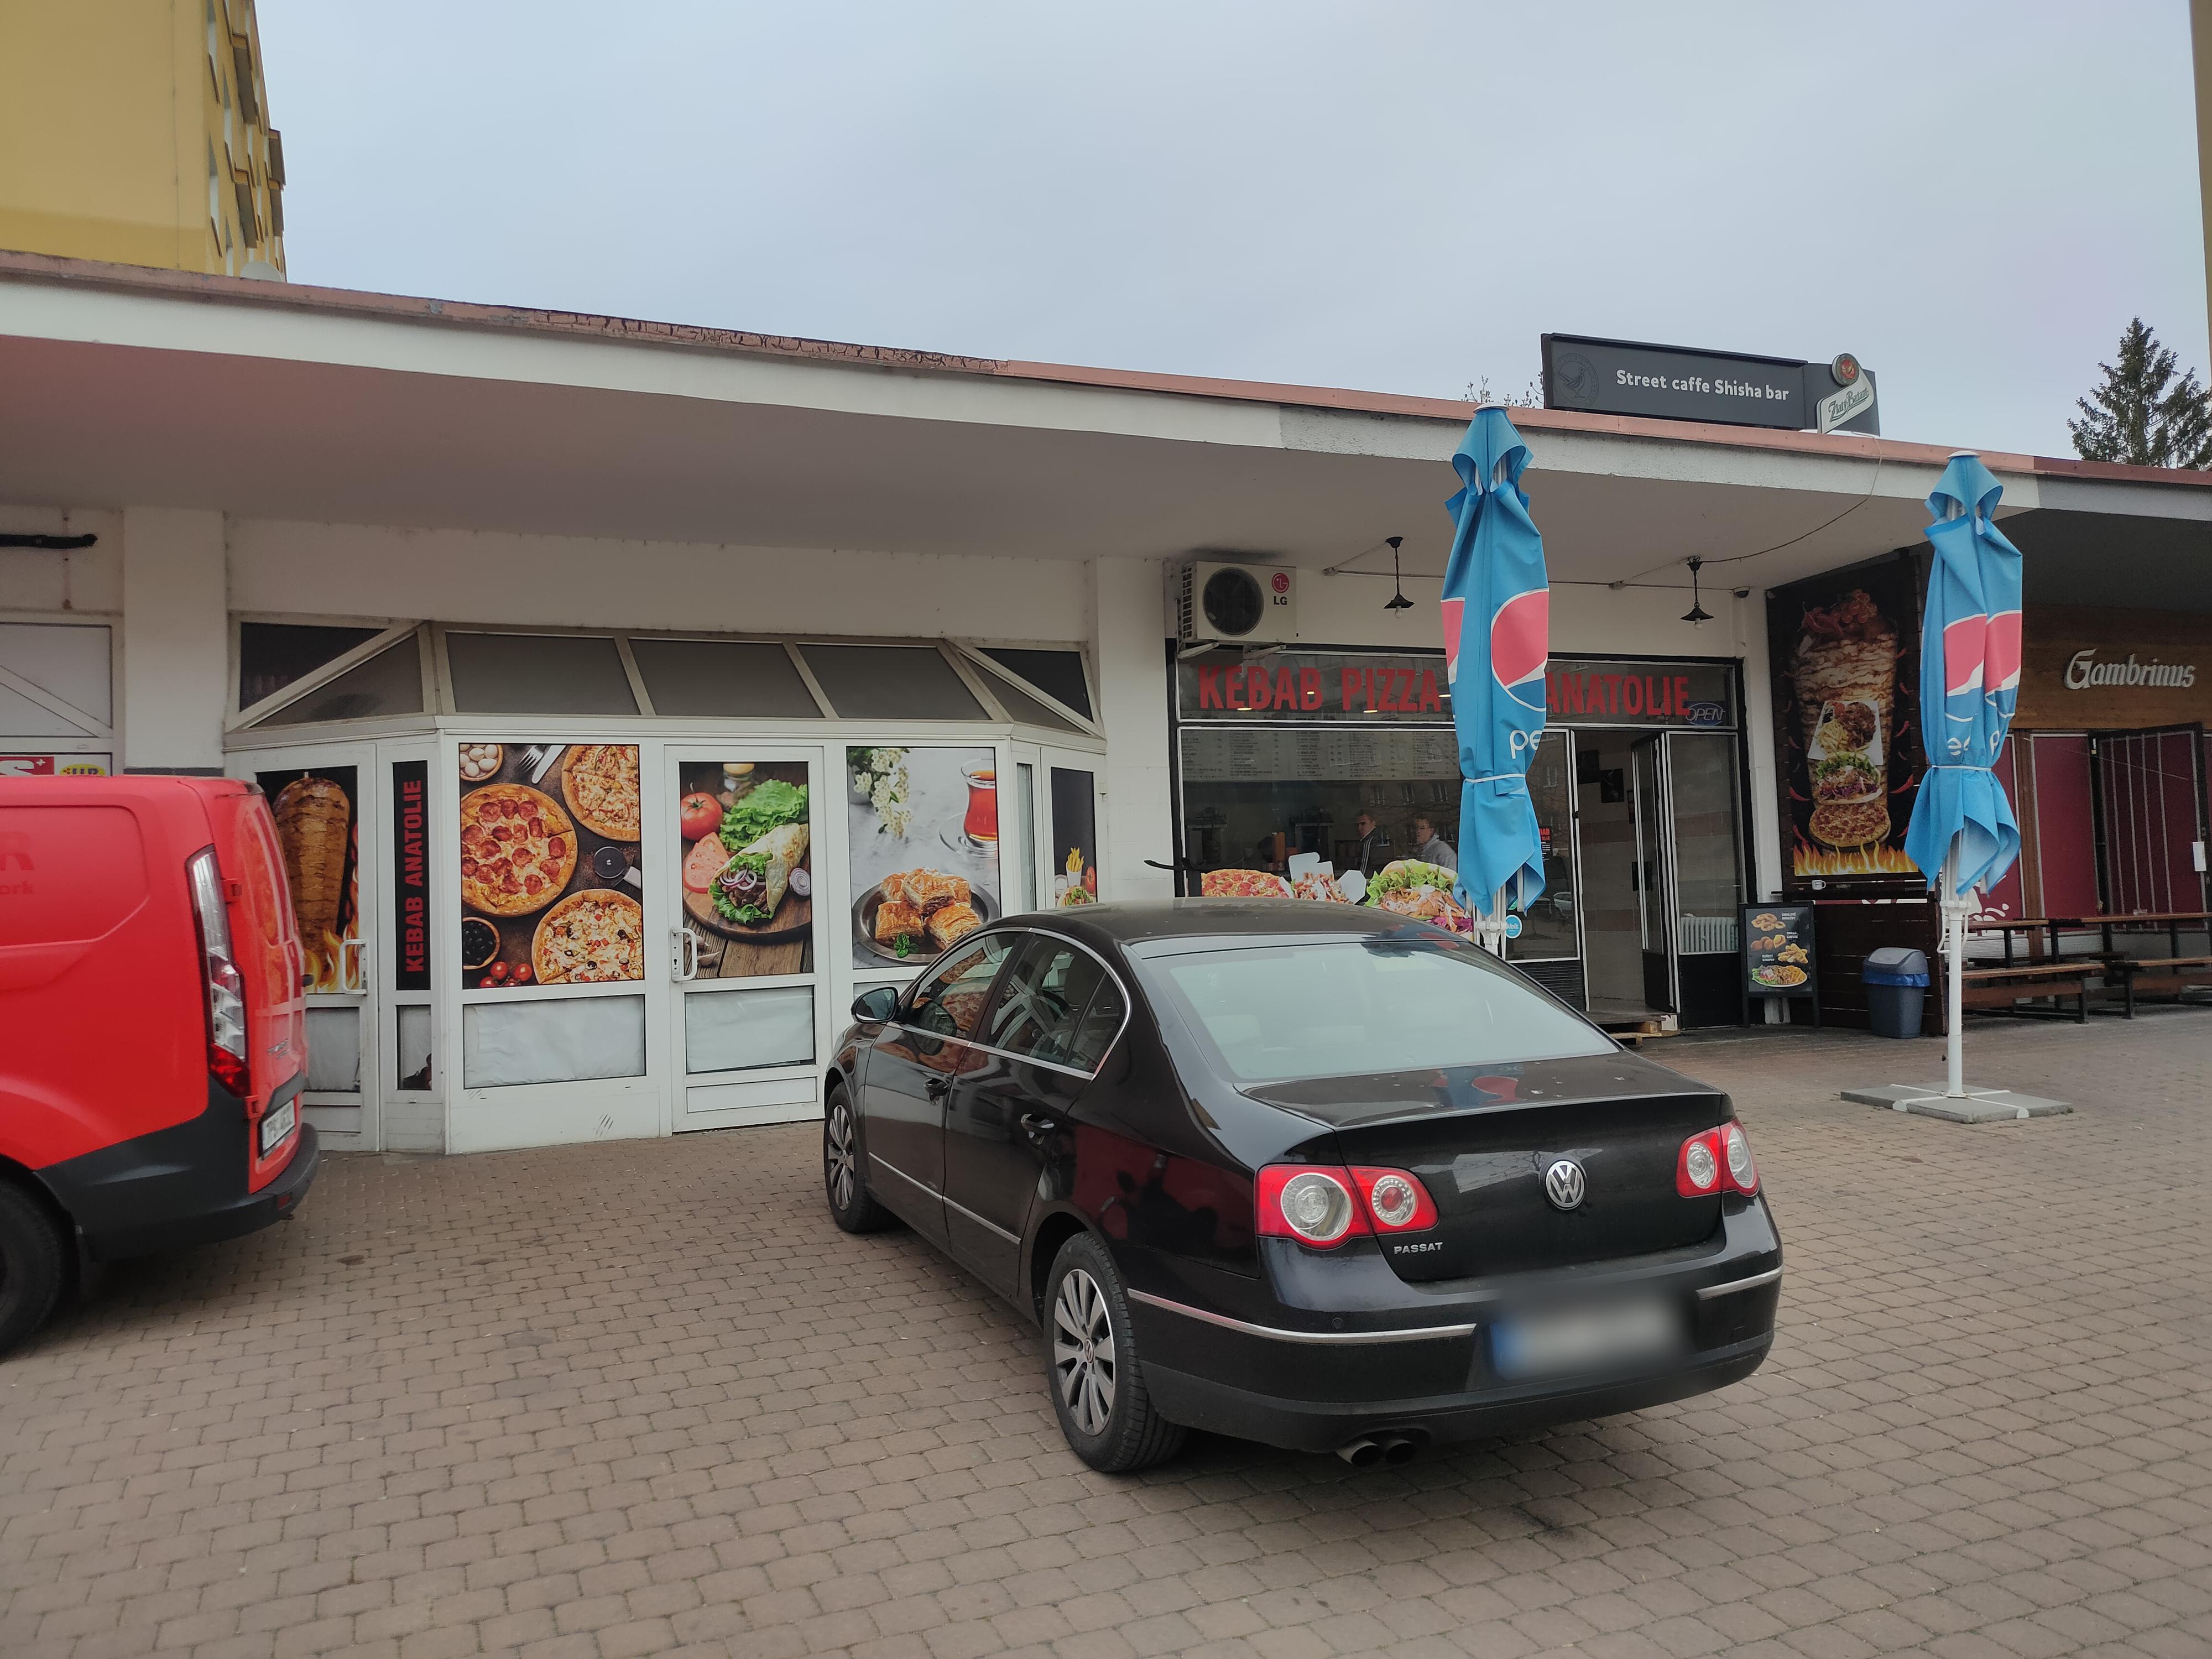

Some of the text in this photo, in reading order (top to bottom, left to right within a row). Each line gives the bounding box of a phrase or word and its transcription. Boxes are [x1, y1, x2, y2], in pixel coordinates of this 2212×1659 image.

[1616, 369, 1789, 400] Street caffe Shisha bar
[1274, 596, 1287, 605] LG
[2066, 648, 2195, 690] Gambrinus
[1199, 665, 1690, 715] KEBAB PIZZA ANATOLIE
[1686, 708, 1723, 721] OPEN
[404, 780, 424, 972] KEBAB ANATOLIE
[1394, 1241, 1443, 1255] PASSAT
